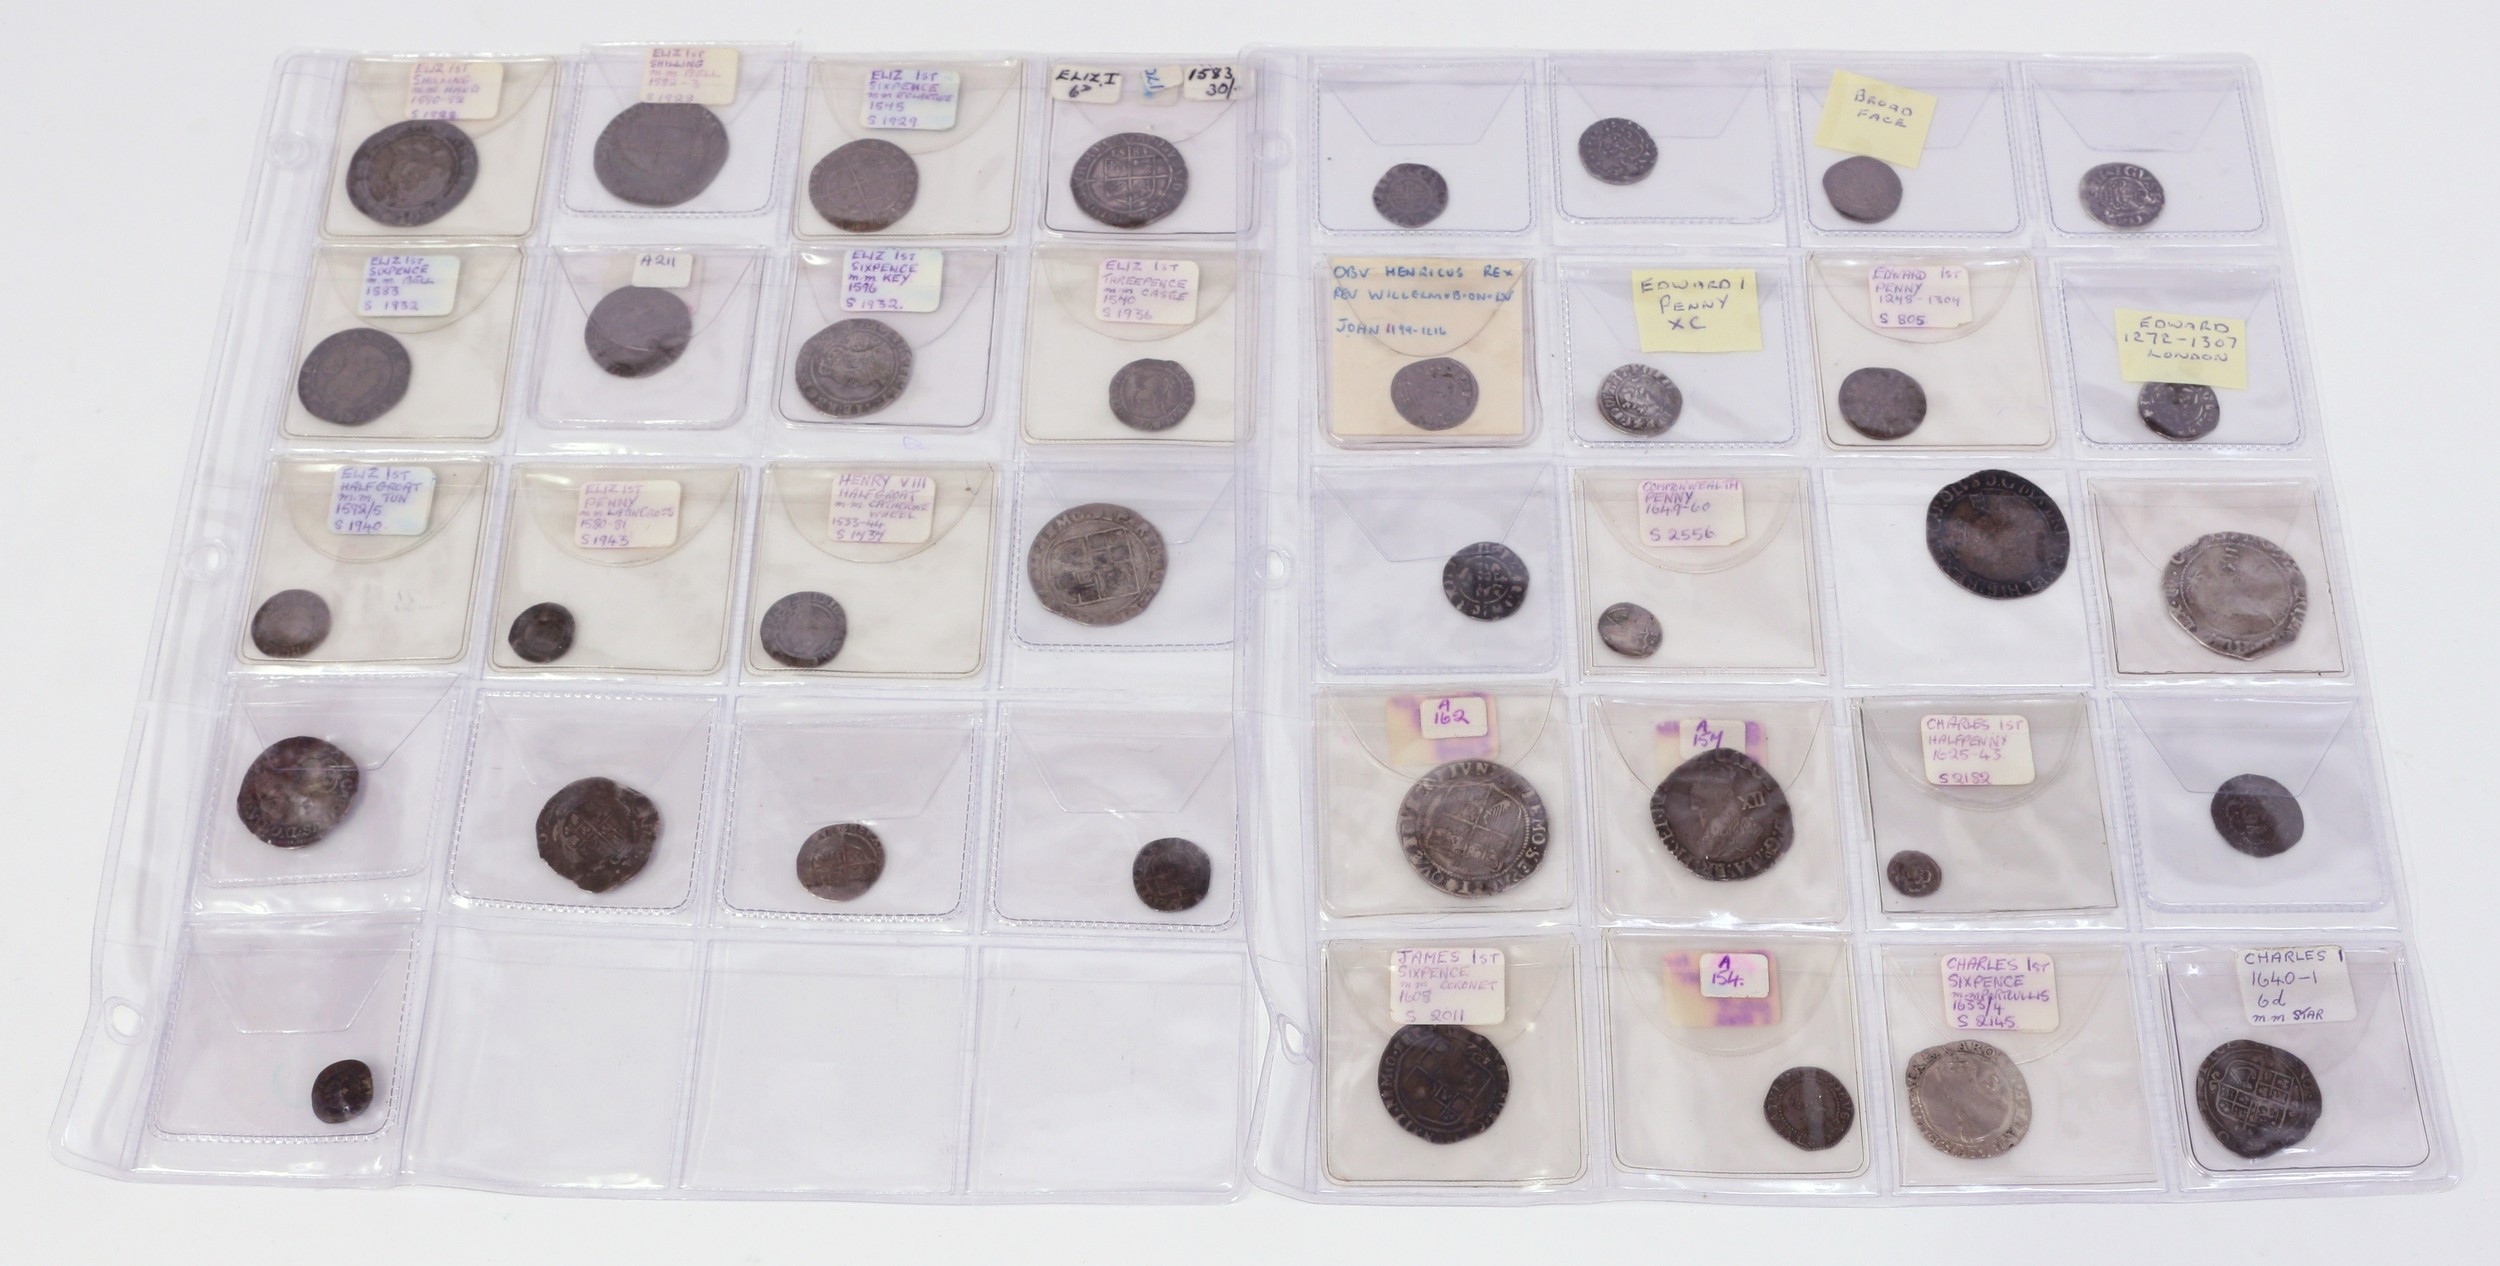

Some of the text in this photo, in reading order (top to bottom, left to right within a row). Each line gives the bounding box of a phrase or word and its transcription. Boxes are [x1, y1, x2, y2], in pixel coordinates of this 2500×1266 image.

[649, 59, 705, 69] SHILLING
[412, 74, 472, 86] SHILLING
[870, 69, 903, 81] ELIZ
[1188, 66, 1234, 81] 1583
[869, 80, 940, 93] SIXPENCE
[1854, 88, 1913, 117] BROAD
[867, 114, 877, 126] S
[1856, 108, 1907, 129] FACE
[370, 256, 401, 266] ELIZ
[851, 249, 886, 261] ELIZ
[368, 263, 430, 276] SIXPENCE
[850, 260, 920, 274] SIXPENCE
[1105, 259, 1143, 271] ELIZ
[1333, 265, 1371, 279] OBV
[1385, 265, 1464, 278] HENRICUS
[882, 272, 911, 286] KEY
[1872, 266, 1927, 280] EDWARD
[1101, 272, 1188, 289] THREEPENCE
[1640, 277, 1731, 294] EDWARD
[366, 285, 400, 296] 1583
[1141, 288, 1189, 301] CASTLE
[1333, 286, 1359, 300] REV
[1875, 282, 1923, 297] PENNY
[384, 300, 419, 311] 1932
[845, 297, 857, 308] S
[1659, 293, 1729, 315] PENNY
[1101, 306, 1153, 321] S 1936
[1879, 312, 1926, 326] S 805
[1336, 318, 1380, 336] JOHN
[2139, 315, 2230, 334] EDWARD
[2147, 349, 2228, 362] LONDON
[341, 467, 380, 480] ELIZ
[838, 473, 927, 490] HENRY VIII
[585, 483, 619, 495] ELIZ
[381, 491, 409, 504] TUN
[584, 494, 640, 510] PENNY
[1645, 491, 1694, 505] PENNY
[869, 510, 916, 520] WHEEL
[348, 520, 383, 533] 1940
[581, 533, 630, 546] S 1943
[836, 528, 845, 540] S
[1649, 526, 1715, 542] S 2556
[1438, 698, 1450, 713] A
[1434, 709, 1471, 725] 162
[1926, 715, 1990, 731] CHARLES
[1696, 718, 1708, 733] A
[1928, 734, 2008, 748] HALFPENNY
[1938, 773, 1949, 784] S
[1396, 949, 1460, 965] JAMES
[1718, 954, 1731, 970] A
[1946, 955, 2018, 971] CHARLES
[2244, 950, 2327, 965] CHARLES
[1398, 965, 1470, 980] SIXPENCE
[2251, 969, 2318, 988] 1640-1
[1439, 979, 1499, 991] CORONET
[1947, 973, 2025, 989] SIXPENCE
[1406, 1008, 1465, 1022] S 2011
[2292, 1006, 2324, 1021] STAR
[1957, 1014, 2016, 1029] S 2145
